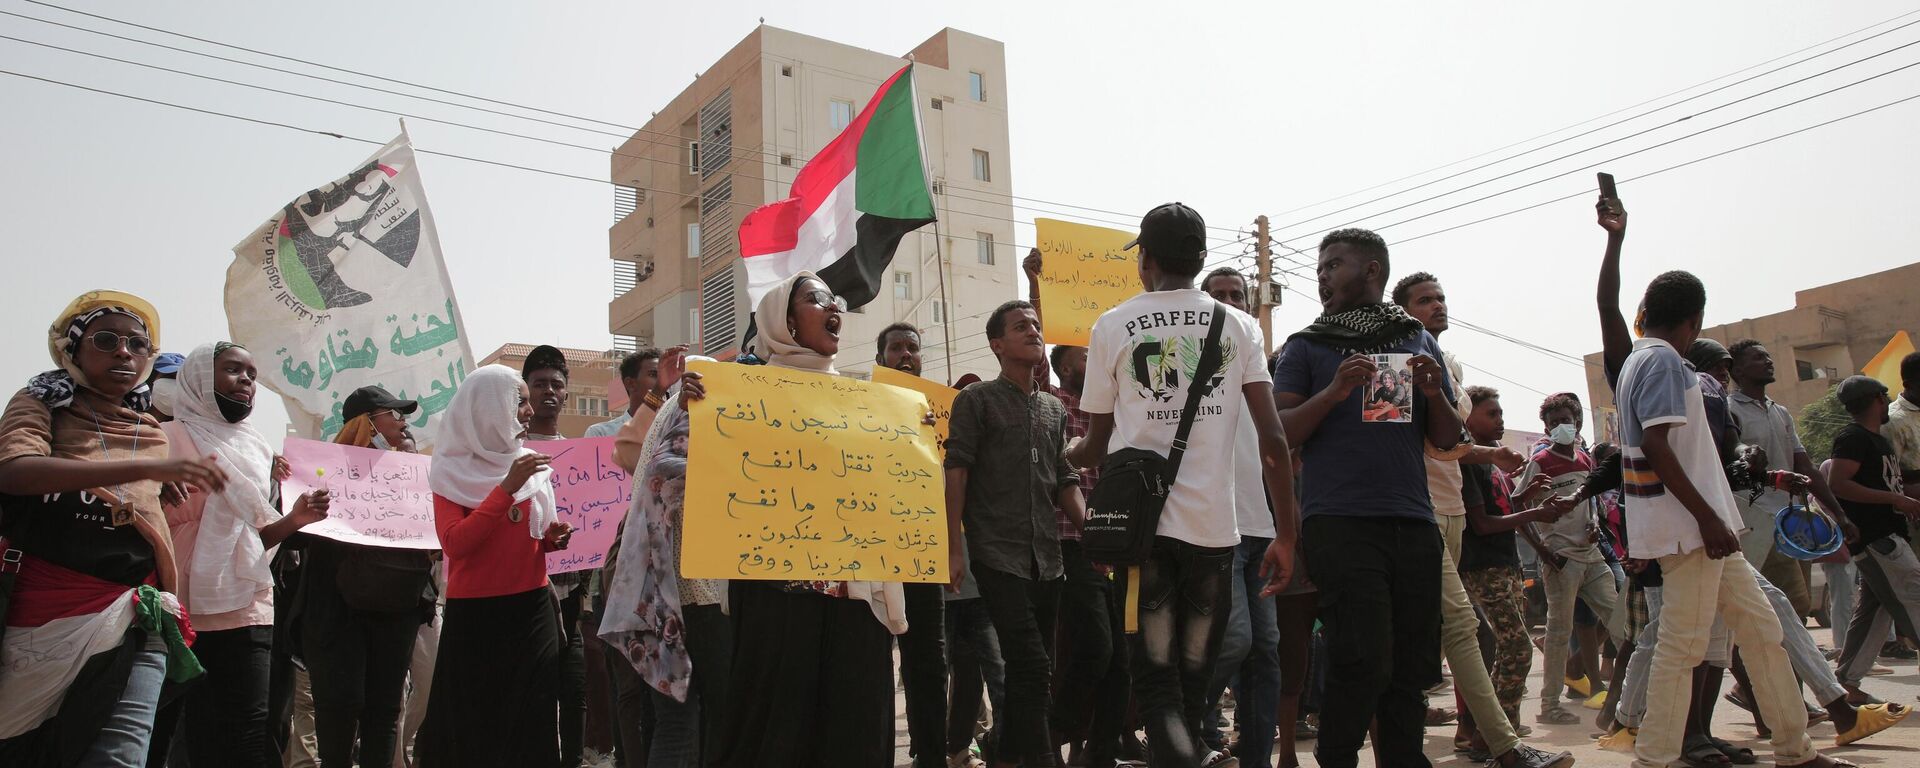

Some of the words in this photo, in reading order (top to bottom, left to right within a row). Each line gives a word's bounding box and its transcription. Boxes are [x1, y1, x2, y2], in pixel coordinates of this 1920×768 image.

[386, 297, 459, 357] لجنة
[1125, 310, 1211, 337] PERFEC
[276, 328, 380, 391] مقاومة
[75, 512, 105, 522] YOUR
[1085, 507, 1129, 525] Champion
